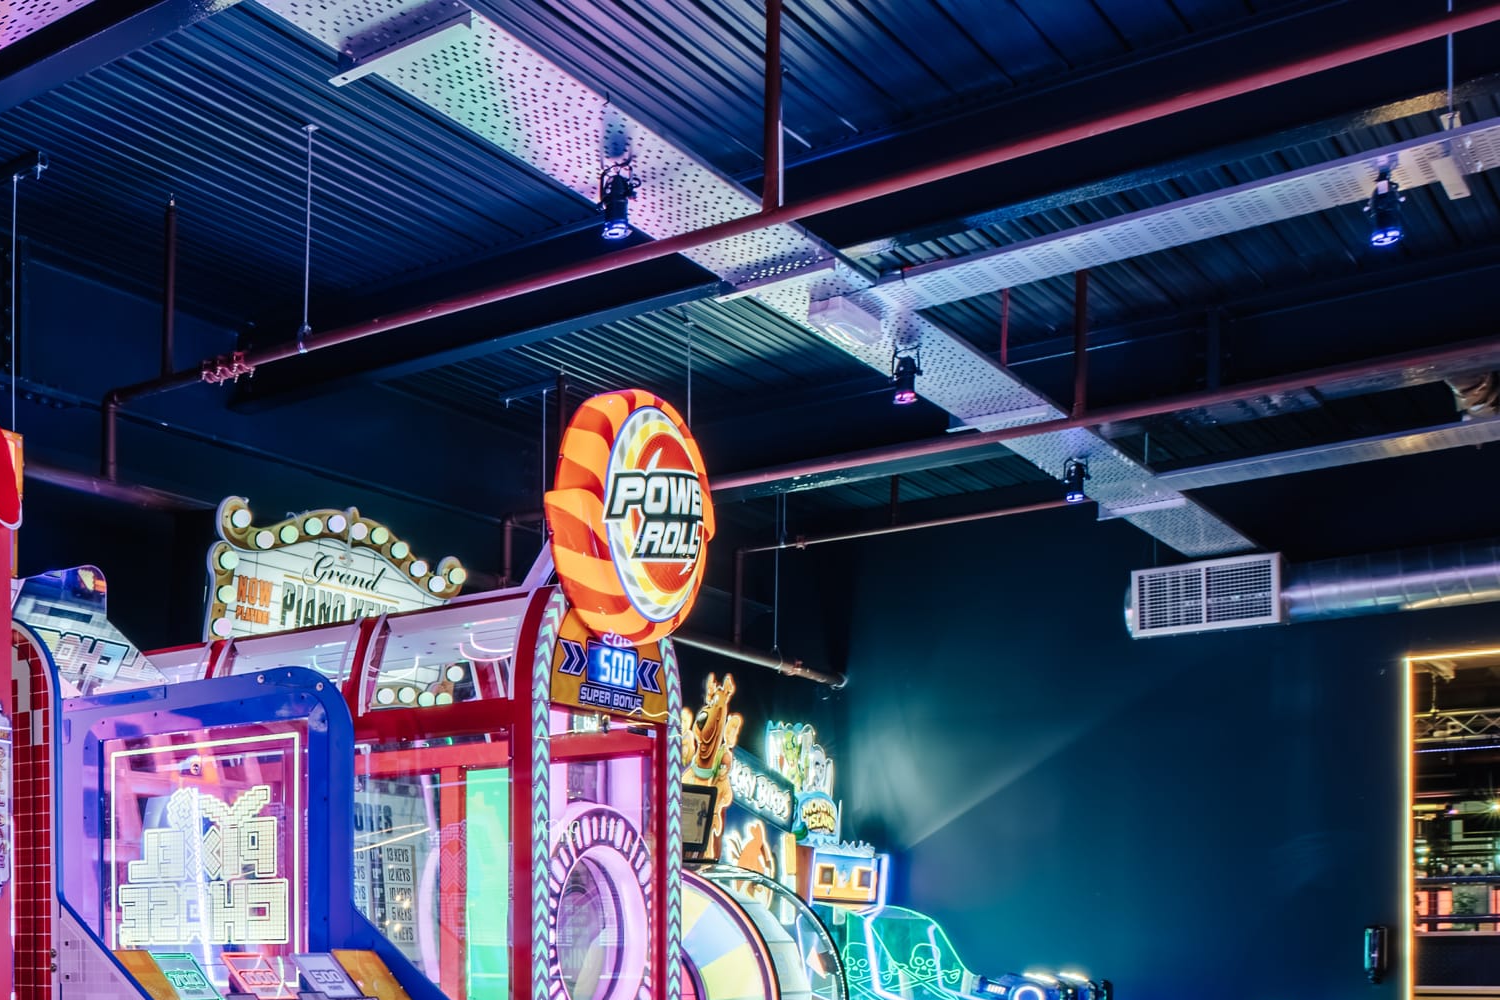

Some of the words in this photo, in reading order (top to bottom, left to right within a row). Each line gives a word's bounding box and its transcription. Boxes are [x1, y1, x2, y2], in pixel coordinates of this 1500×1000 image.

[301, 550, 387, 592] Grand
[237, 575, 274, 608] NOW
[598, 647, 637, 689] 500
[580, 686, 612, 705] SUPER
[612, 692, 643, 711] BONUS
[396, 868, 411, 883] KEYS
[311, 969, 344, 984] 500
